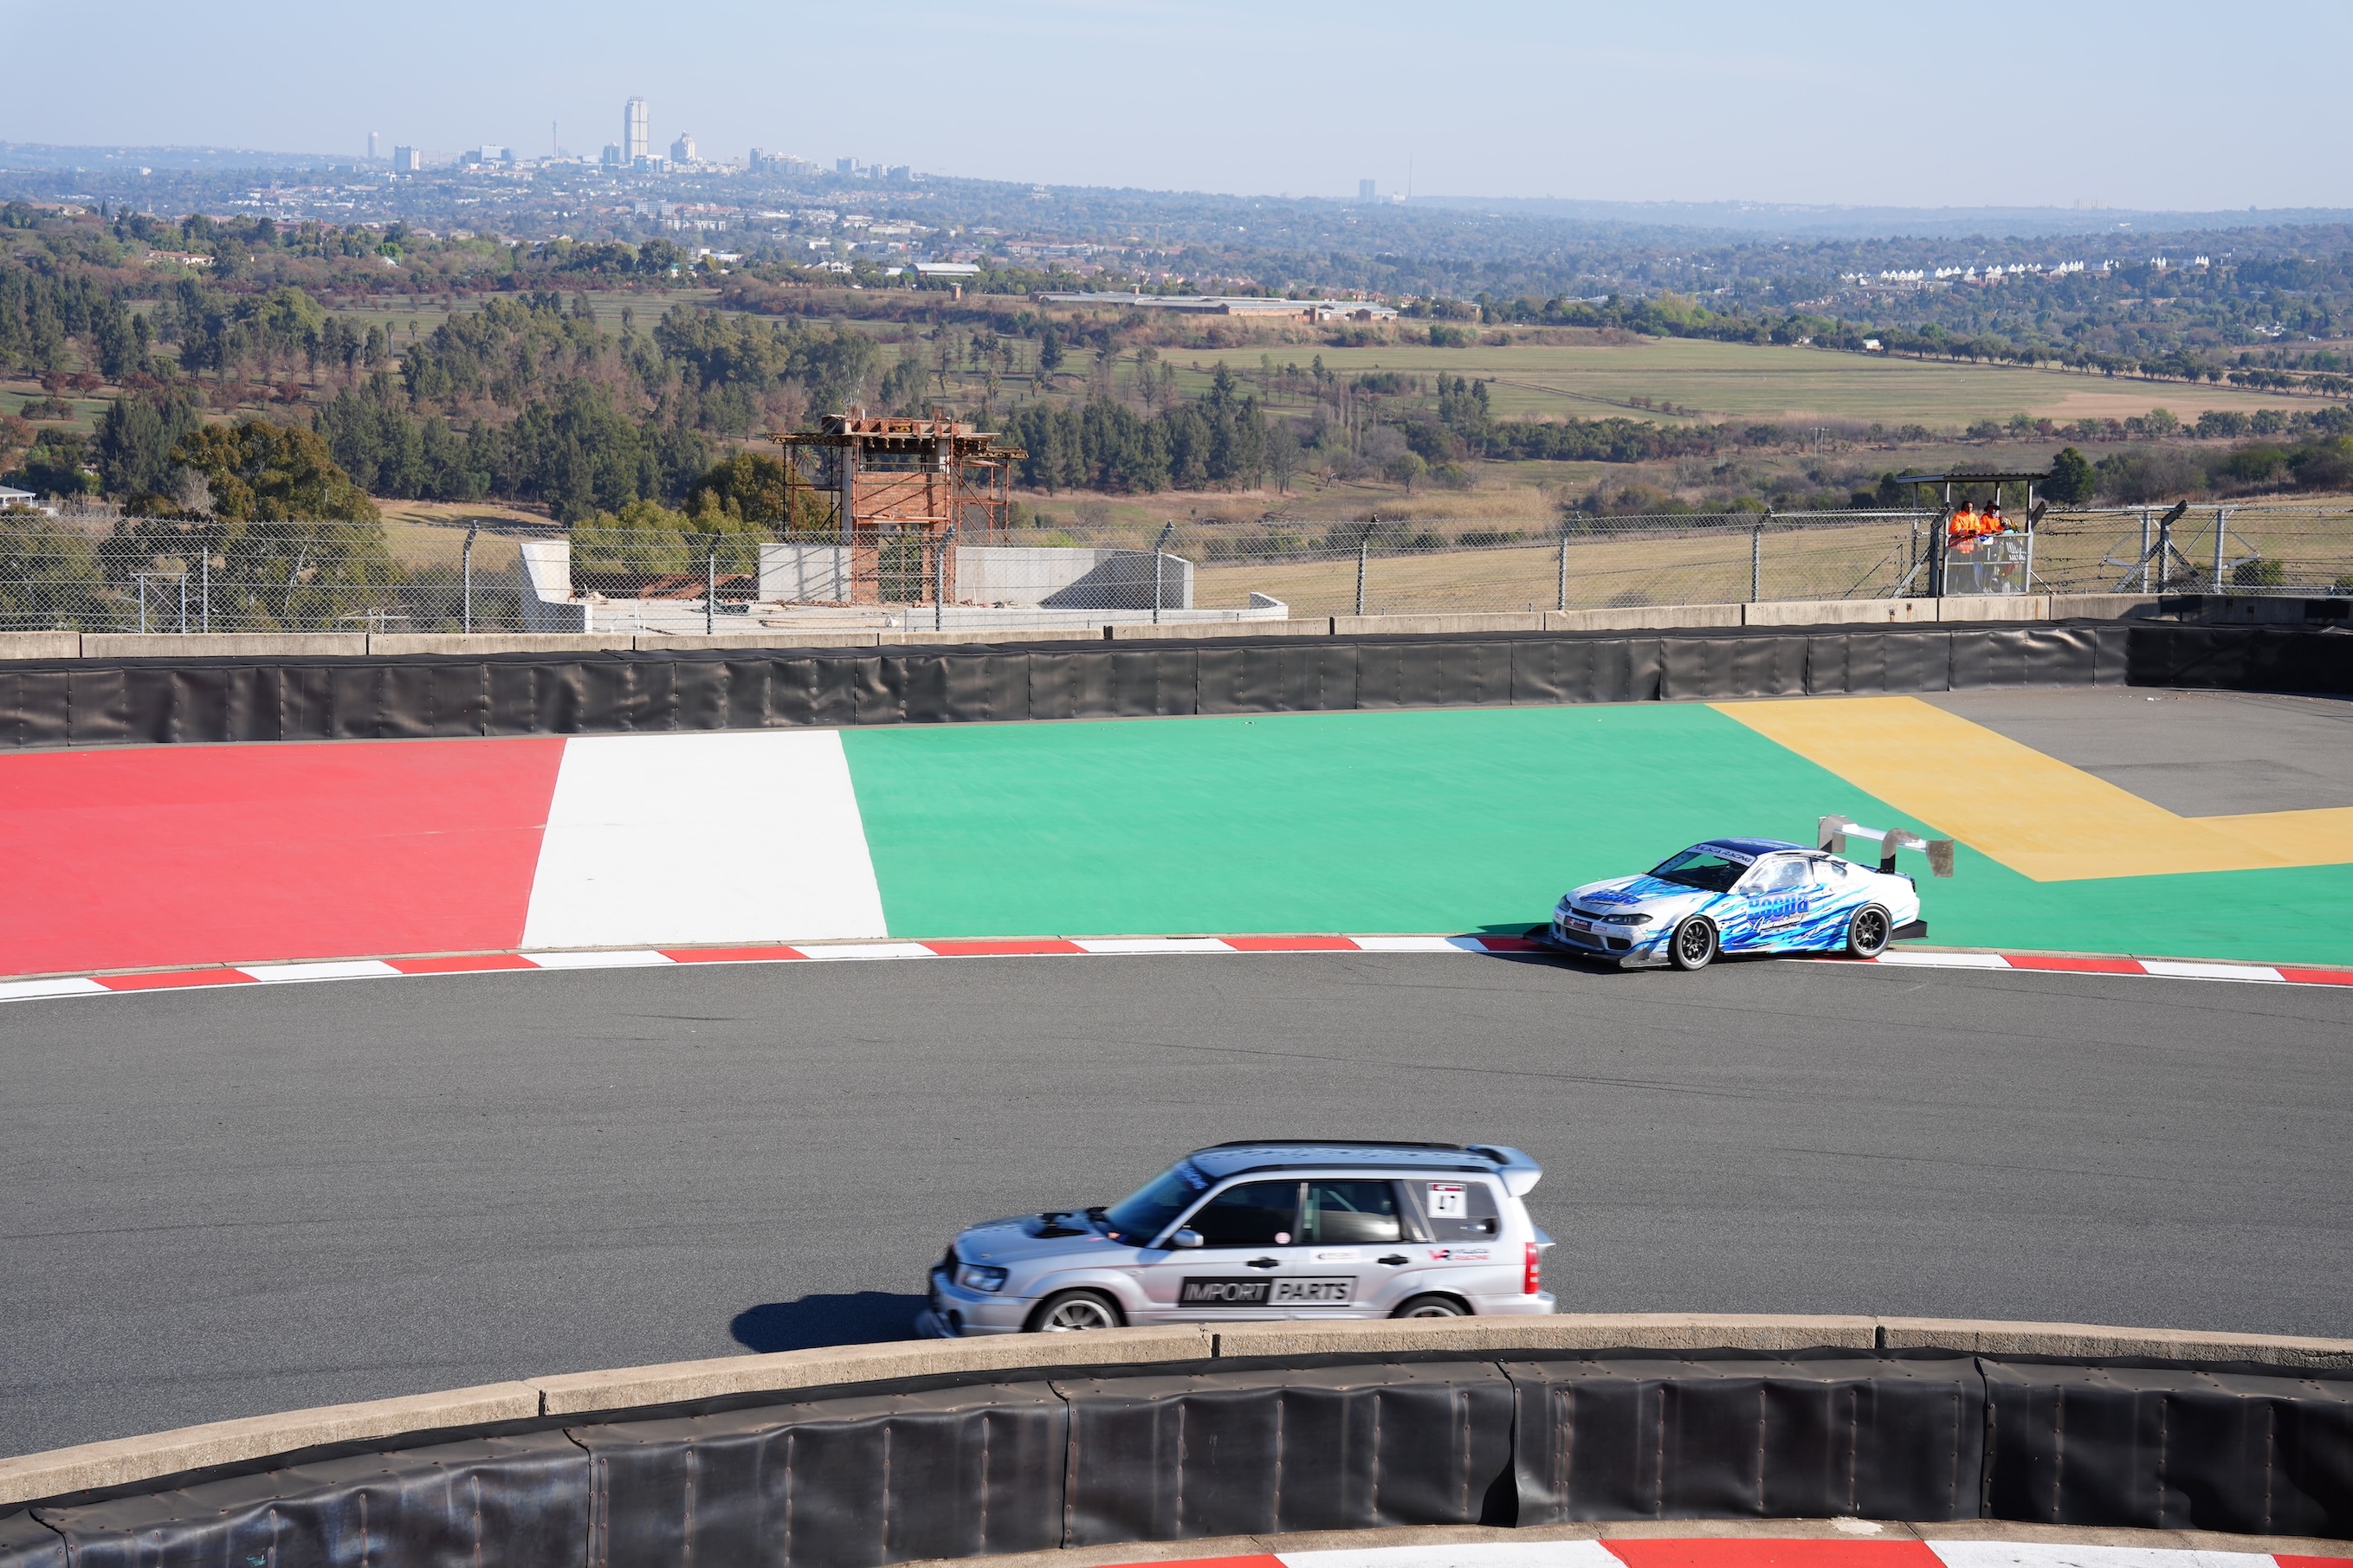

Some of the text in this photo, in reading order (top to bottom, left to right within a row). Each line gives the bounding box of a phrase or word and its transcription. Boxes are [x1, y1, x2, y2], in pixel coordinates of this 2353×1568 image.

[1722, 850, 1753, 862] RACING
[1183, 1282, 1348, 1300] IMPORT PARTS
